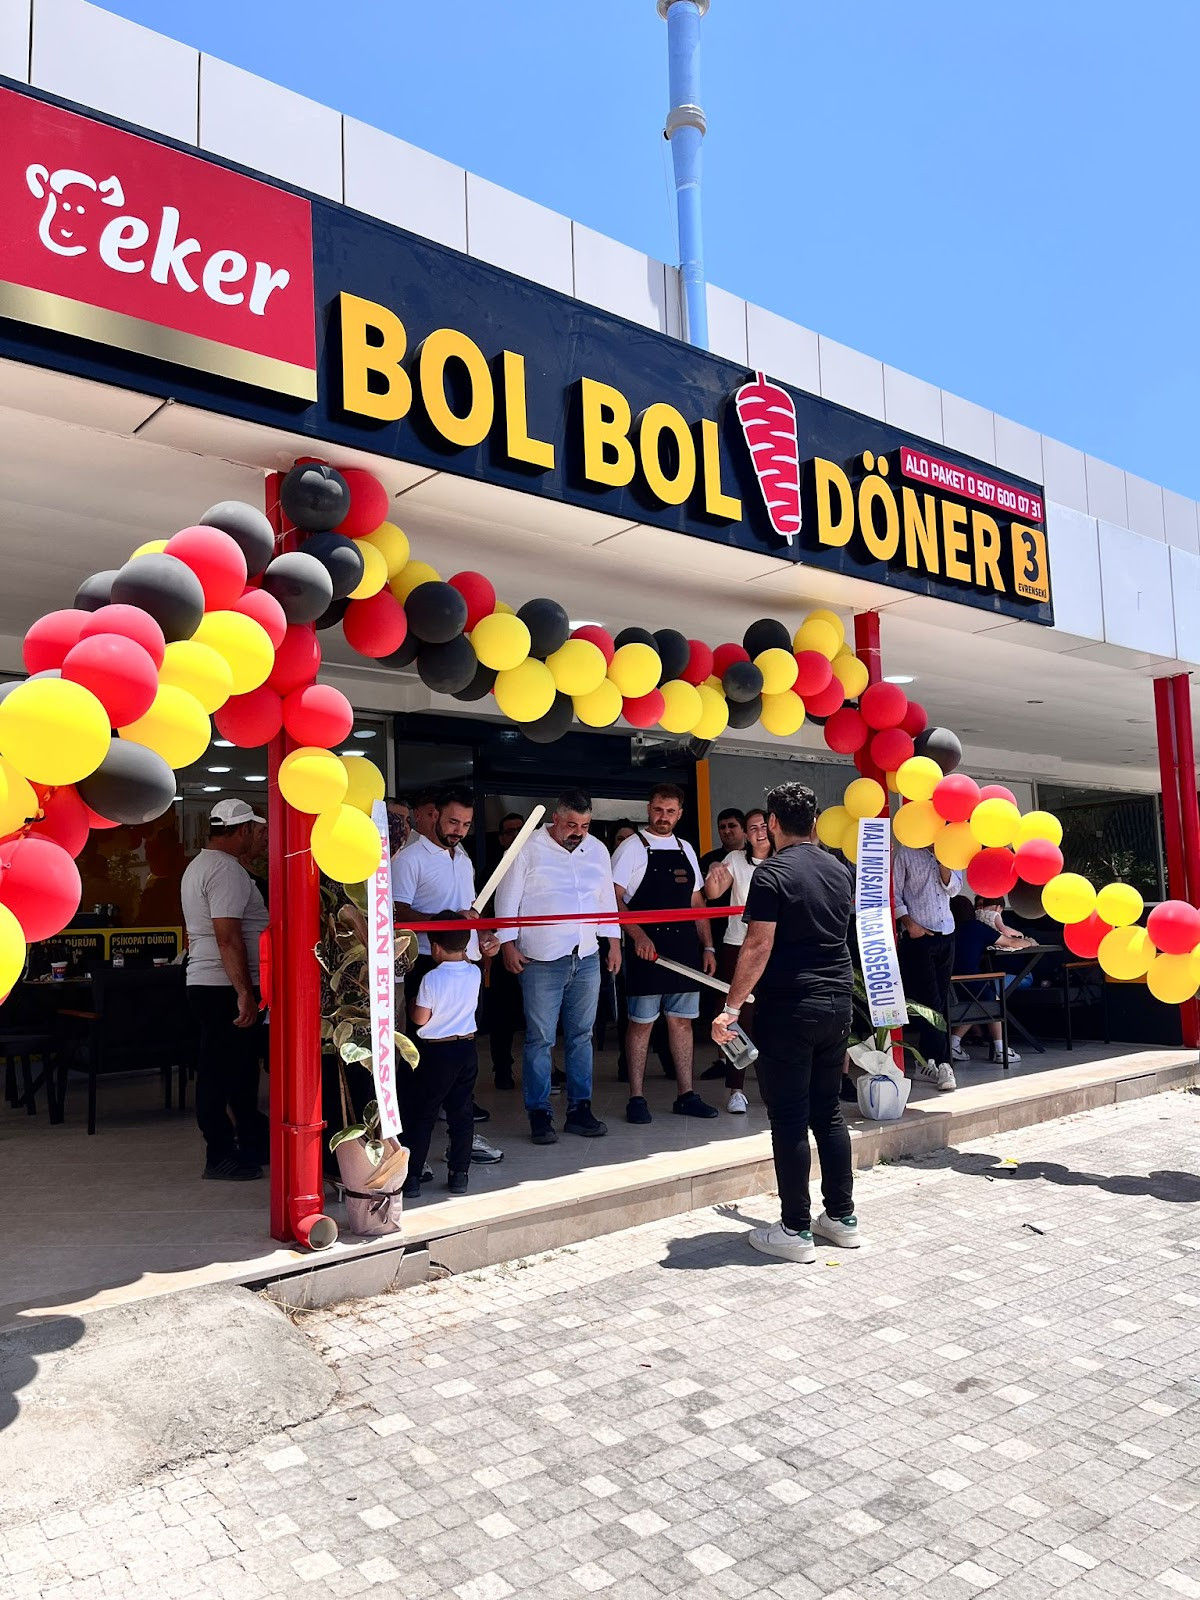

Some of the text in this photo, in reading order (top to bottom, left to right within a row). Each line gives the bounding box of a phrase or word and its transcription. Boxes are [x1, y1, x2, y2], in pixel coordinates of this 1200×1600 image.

[339, 290, 1007, 593] BOL BOL DÖNER
[905, 454, 1042, 518] ALO PAKET 0 507 600 07 31
[1021, 531, 1040, 582] 3
[1018, 582, 1047, 599] EVRENSEKİ
[862, 823, 890, 852] MALİ
[859, 855, 889, 910] MÜŞAVİR
[65, 936, 97, 948] DÜRÜM
[111, 933, 175, 946] PSİKOPAT DÜRÜM
[860, 908, 885, 939] TOLGA
[376, 965, 390, 1008] ET
[863, 938, 899, 1008] KÖSEOĞLU
[378, 1015, 400, 1129] KASAP
